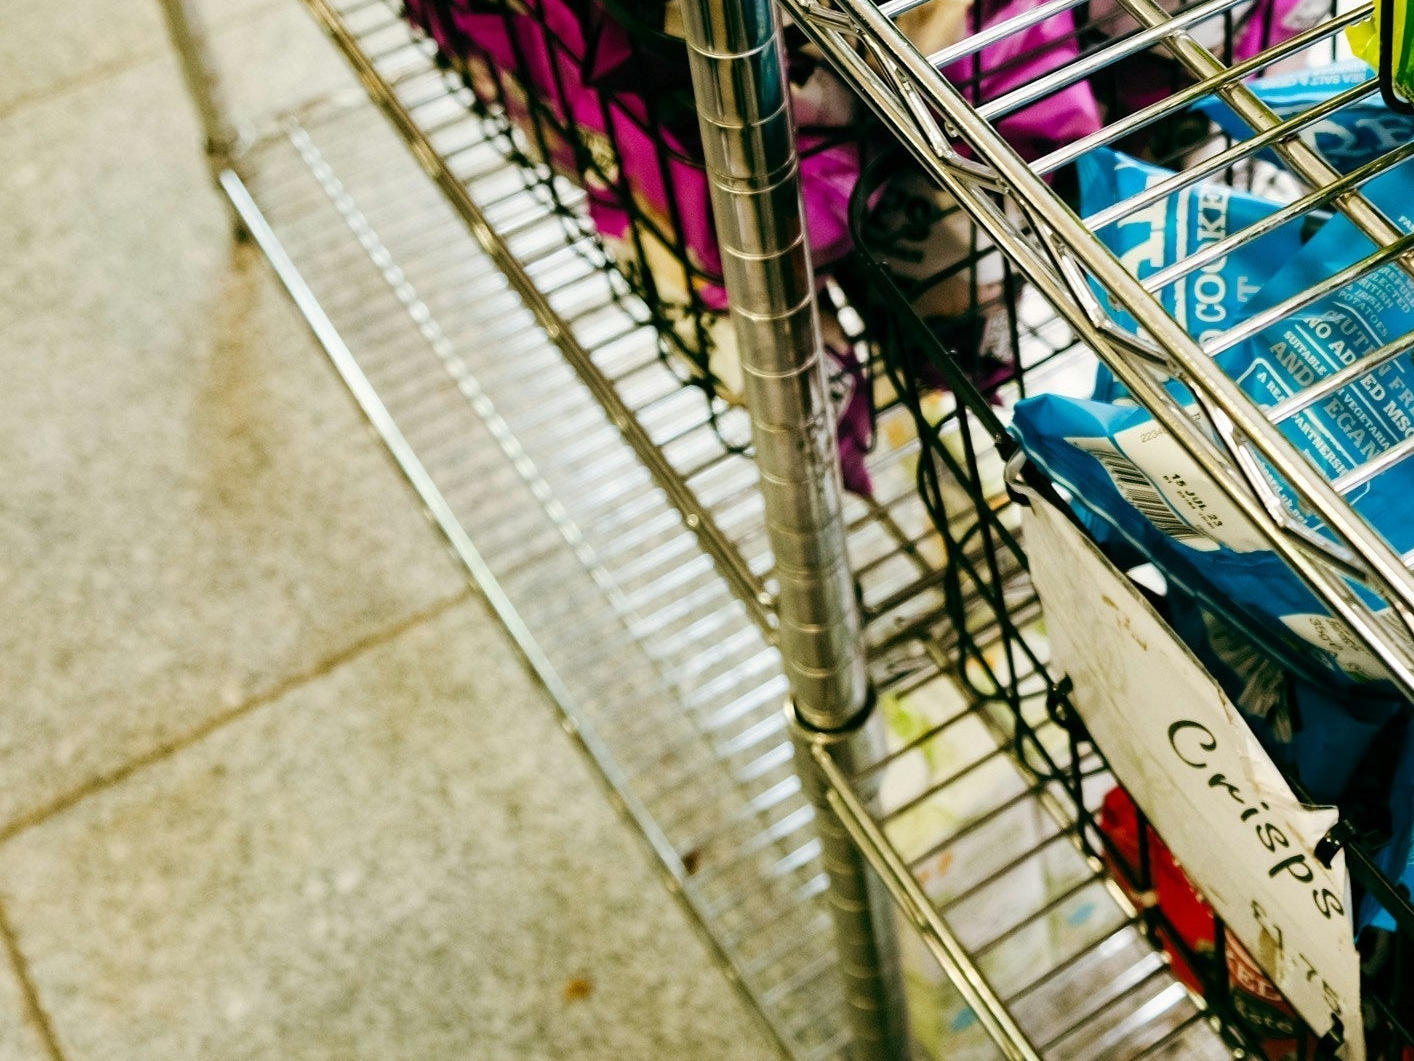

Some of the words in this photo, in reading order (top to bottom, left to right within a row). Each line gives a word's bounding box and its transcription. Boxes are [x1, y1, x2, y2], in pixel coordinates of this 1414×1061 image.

[1193, 191, 1230, 322] COOKE
[1268, 337, 1316, 392] AND
[1322, 396, 1382, 465] EGAN
[1282, 327, 1327, 379] SUITABLE
[1341, 392, 1391, 452] VEGETARIA
[1302, 310, 1333, 342] NO
[1327, 334, 1388, 405] ADED
[1170, 471, 1186, 489] 15
[1184, 485, 1207, 514] JUL
[1206, 511, 1223, 529] 23
[1289, 408, 1348, 479] PARTNERSH
[1168, 719, 1346, 921] Crisps
